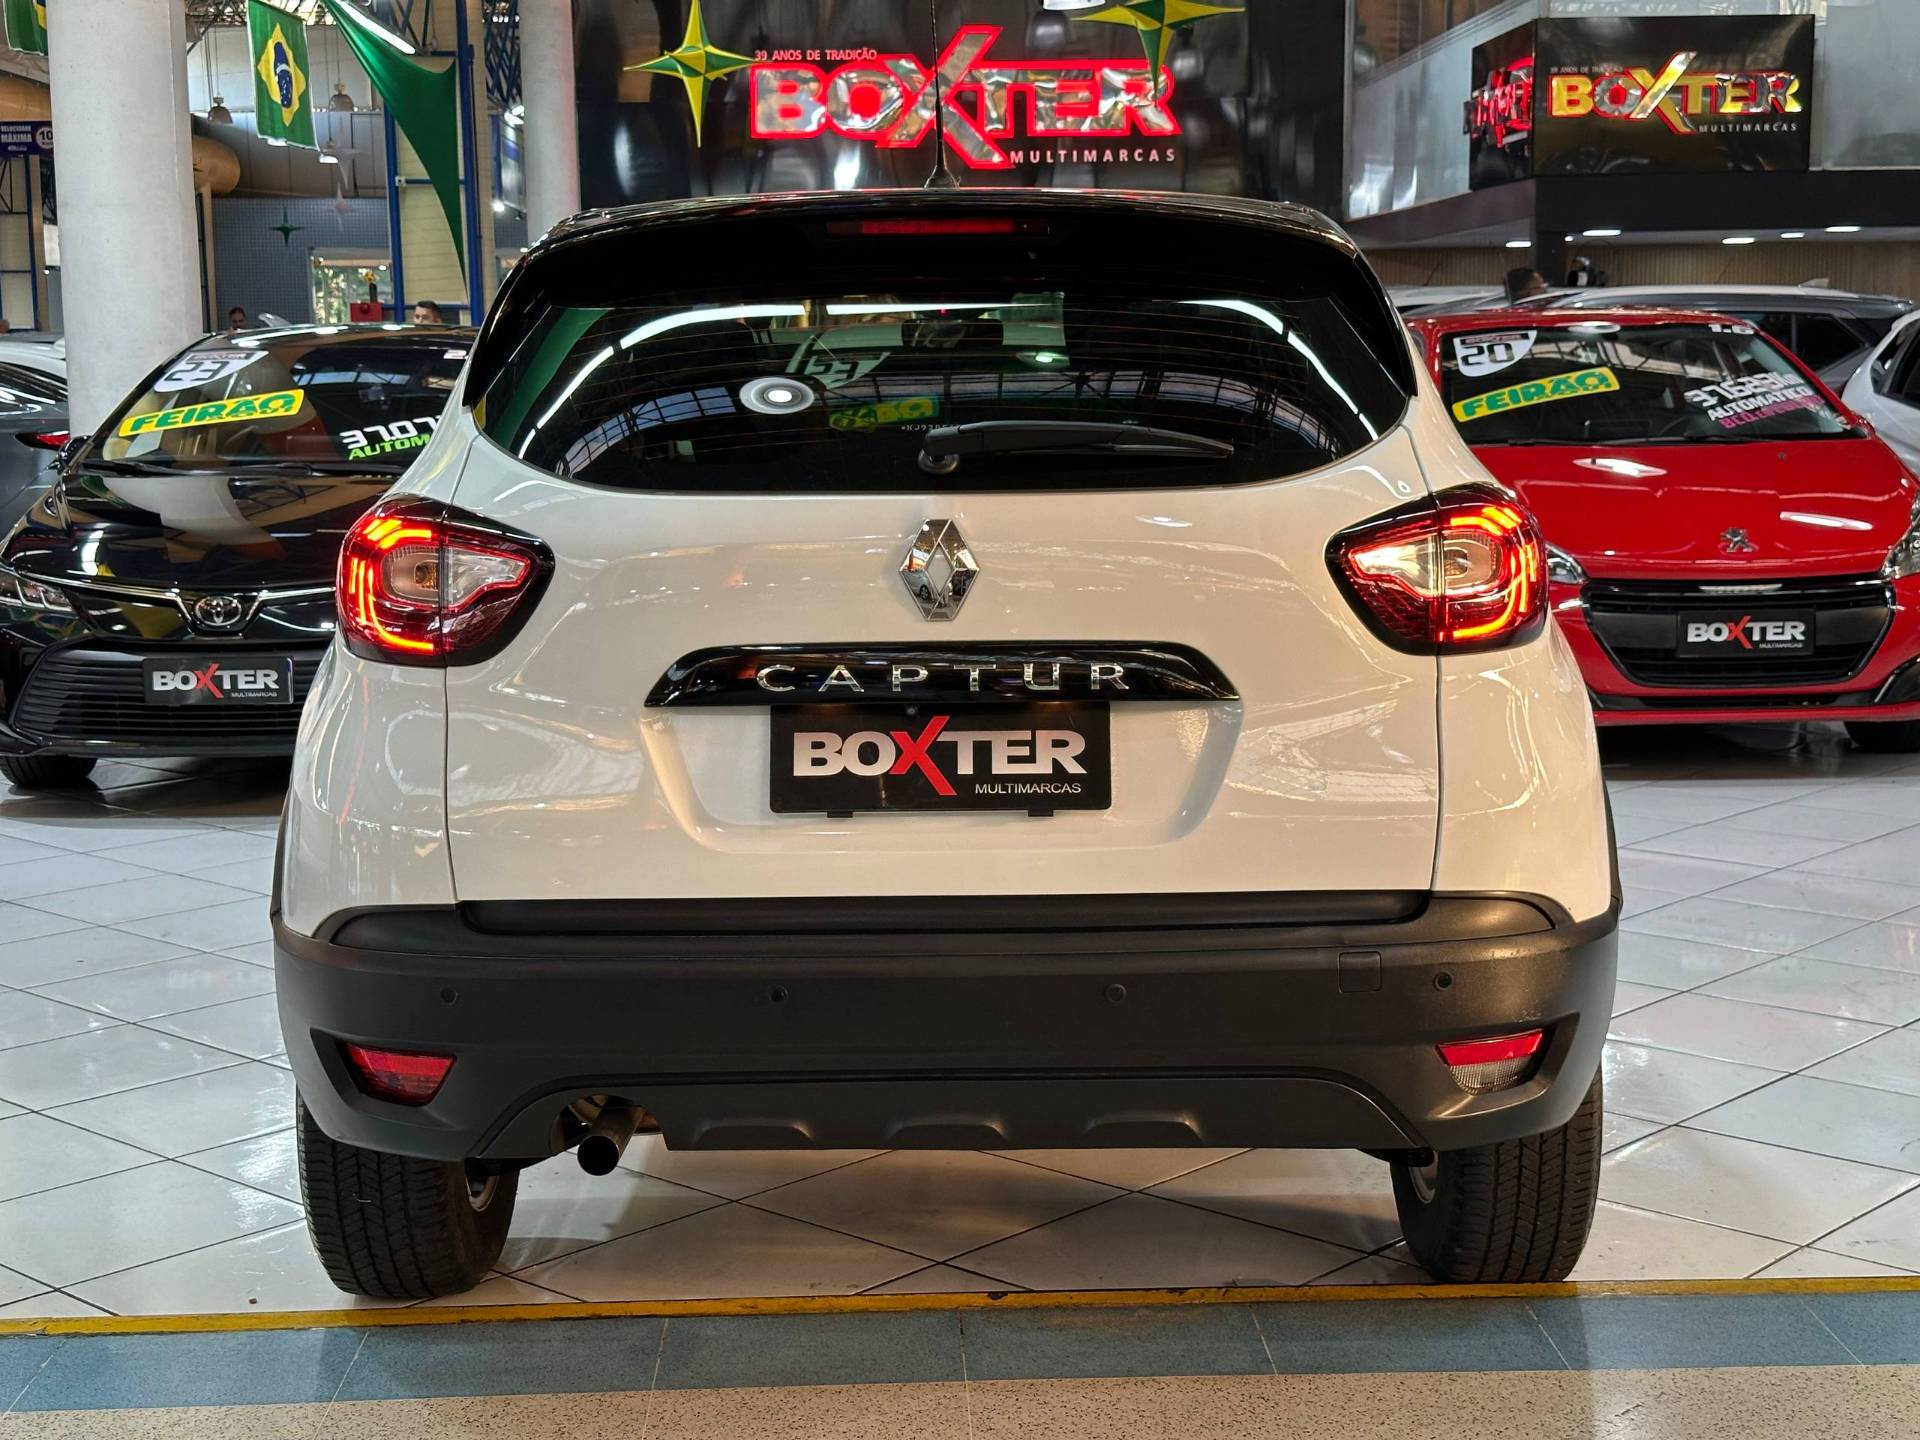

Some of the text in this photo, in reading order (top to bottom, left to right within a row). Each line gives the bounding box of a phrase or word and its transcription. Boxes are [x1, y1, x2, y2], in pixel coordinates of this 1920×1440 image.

[754, 47, 878, 62] 39 ANOS DE TRADIÇÃO
[749, 25, 1183, 169] BOXTER
[1548, 51, 1802, 135] BOXTER
[40, 130, 53, 141] 10
[1699, 122, 1798, 134] MULTIMARCAS
[1010, 148, 1176, 164] MULTIMARCAS
[1461, 342, 1516, 367] 20
[164, 360, 230, 382] 23
[1687, 615, 1806, 649] BOXTER
[153, 663, 280, 699] BOXTER
[756, 663, 1130, 692] CAPTUR
[793, 715, 1088, 796] BOXTER
[974, 782, 1082, 795] MULTIMARCAS
